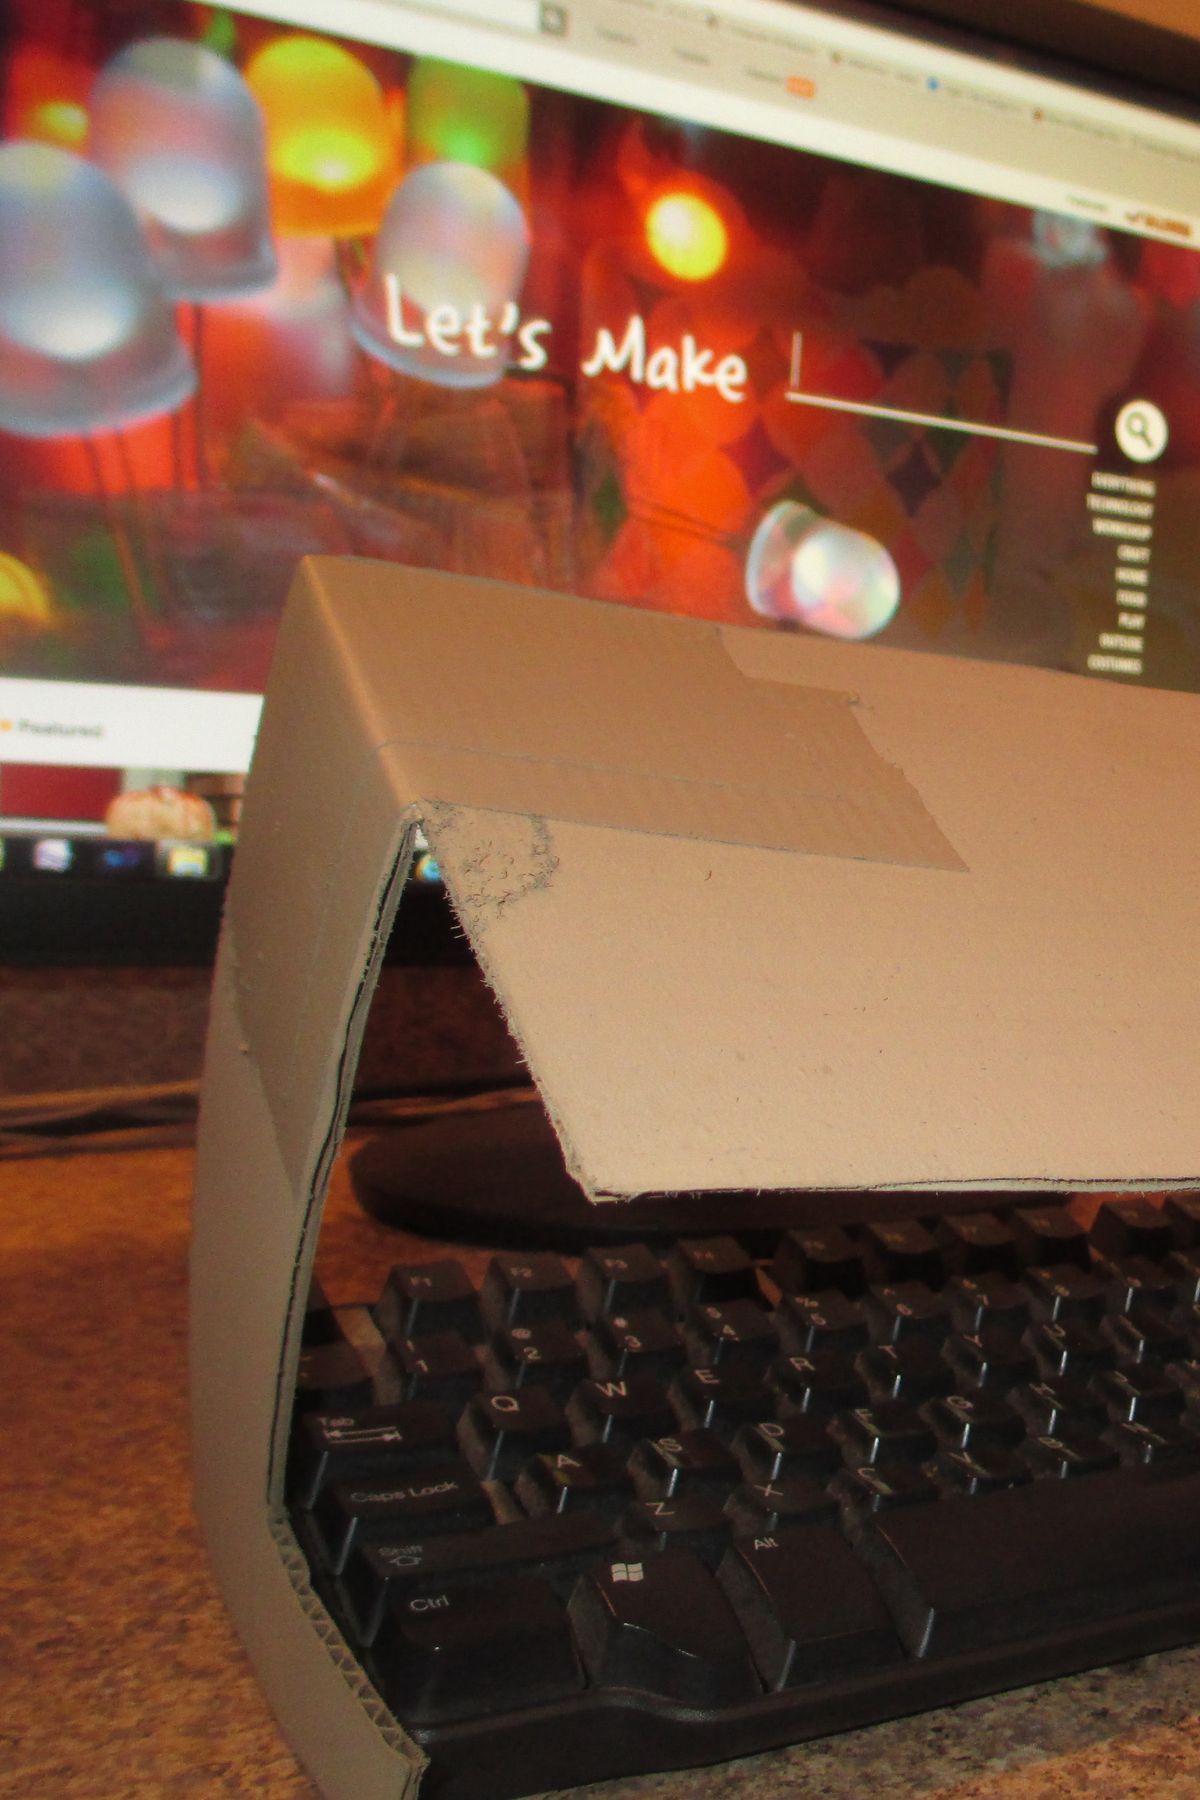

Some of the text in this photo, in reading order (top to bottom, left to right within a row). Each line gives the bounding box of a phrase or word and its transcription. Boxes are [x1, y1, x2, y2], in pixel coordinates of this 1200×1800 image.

[384, 272, 747, 404] Let's Make
[18, 720, 103, 738] Featured
[350, 1481, 458, 1503] Caps Lock
[754, 1484, 784, 1497] X
[645, 1502, 675, 1516] Z
[754, 1536, 779, 1549] Alt
[409, 1594, 450, 1612] Ctrl
